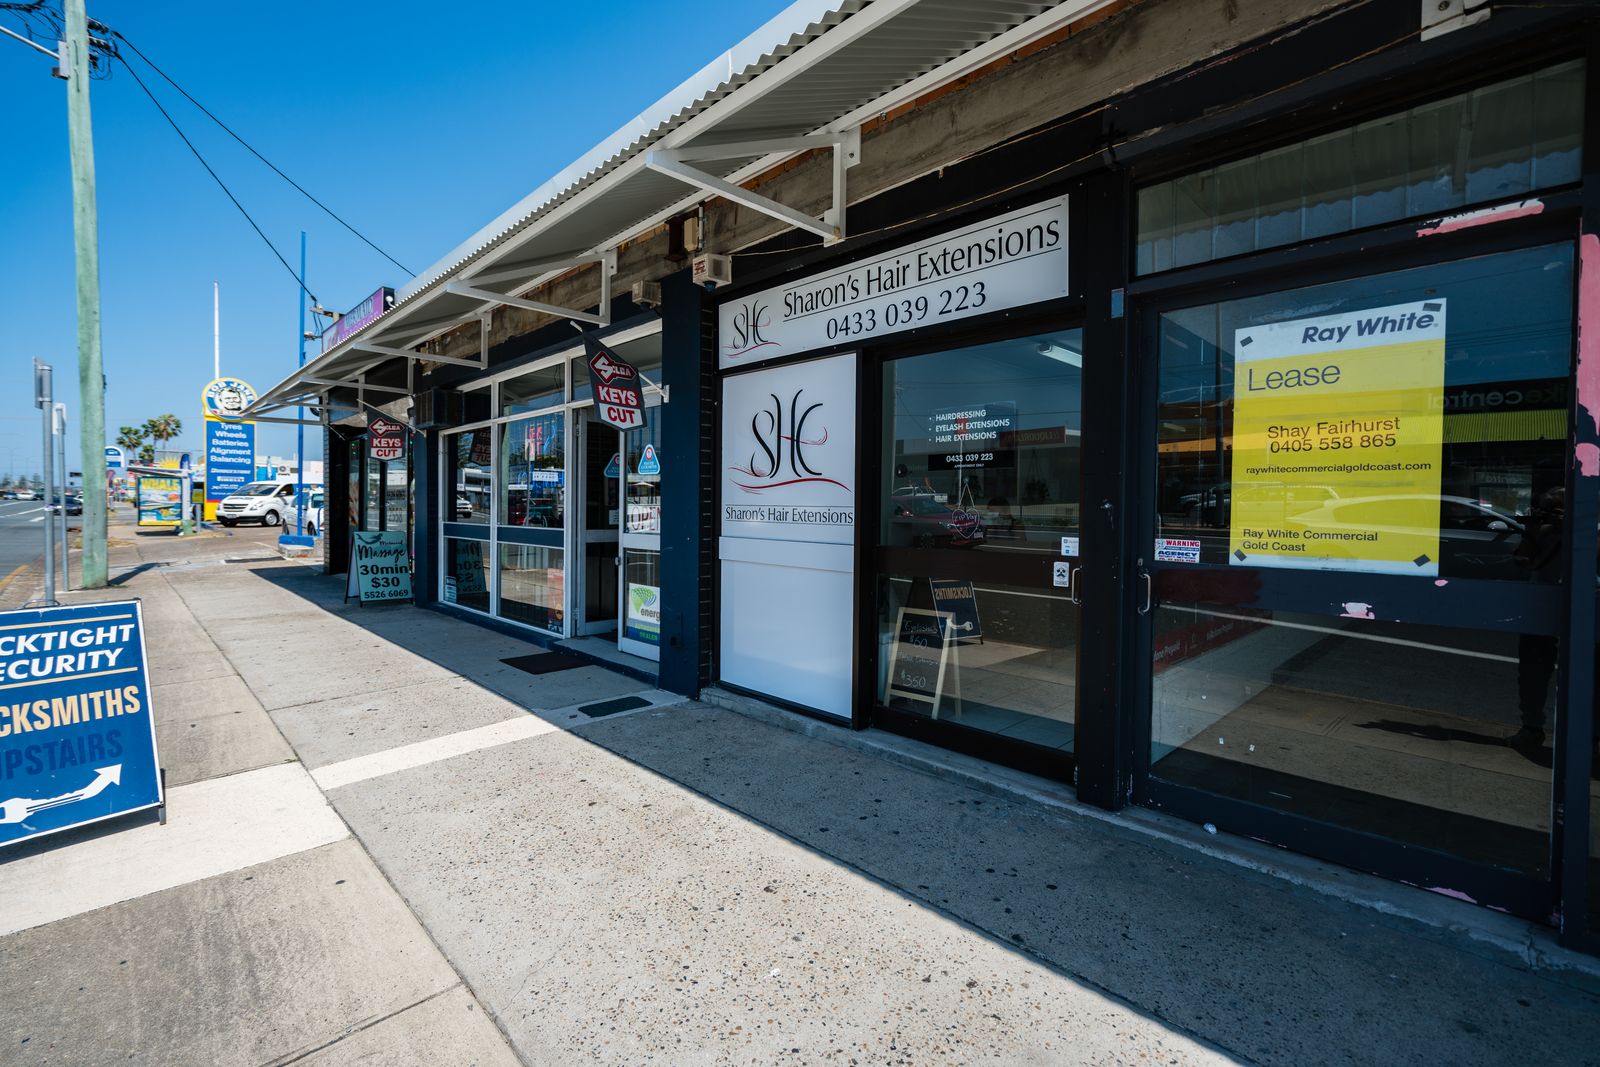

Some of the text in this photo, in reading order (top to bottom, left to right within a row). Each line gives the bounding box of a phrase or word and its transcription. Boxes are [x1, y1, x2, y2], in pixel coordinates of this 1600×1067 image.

[784, 219, 1060, 318] Sharon's Hair Extensions
[826, 281, 987, 340] 0433 039 223
[1301, 312, 1435, 345] Ray White
[1248, 364, 1341, 392] Lease
[598, 385, 638, 406] KEYS
[607, 406, 635, 424] CUT
[935, 409, 987, 421] HAIRDRESSING
[220, 422, 243, 430] Tyres
[935, 418, 1010, 433] EYELASH EXTENSIONS
[1267, 416, 1401, 440] Shay Fairhurst
[215, 430, 247, 438] Wheels
[935, 431, 997, 443] HAIR EXTENSIONS
[212, 438, 249, 447] Batteries
[372, 438, 402, 447] KEYS
[1270, 433, 1396, 453] 0405 558 865
[210, 447, 252, 455] Alignment
[376, 448, 397, 457] CUT
[946, 452, 994, 463] 0433 039 223
[210, 455, 251, 464] Balancing
[1246, 462, 1432, 474] raywhitecommercialgoldcoast.com
[141, 479, 179, 491] WHALE
[725, 506, 853, 524] Sharon's Hair Extensions
[1242, 528, 1378, 542] Ray White Commercial
[1165, 540, 1200, 548] WARNING
[1242, 541, 1306, 552] Gold Coast
[358, 544, 405, 563] Massage
[360, 563, 409, 576] 30min
[371, 576, 400, 589] $30
[364, 588, 409, 599] 5526 6069
[640, 608, 660, 622] energ
[0, 623, 135, 656] CKTIGHT
[0, 728, 124, 781] PSTAIRS
